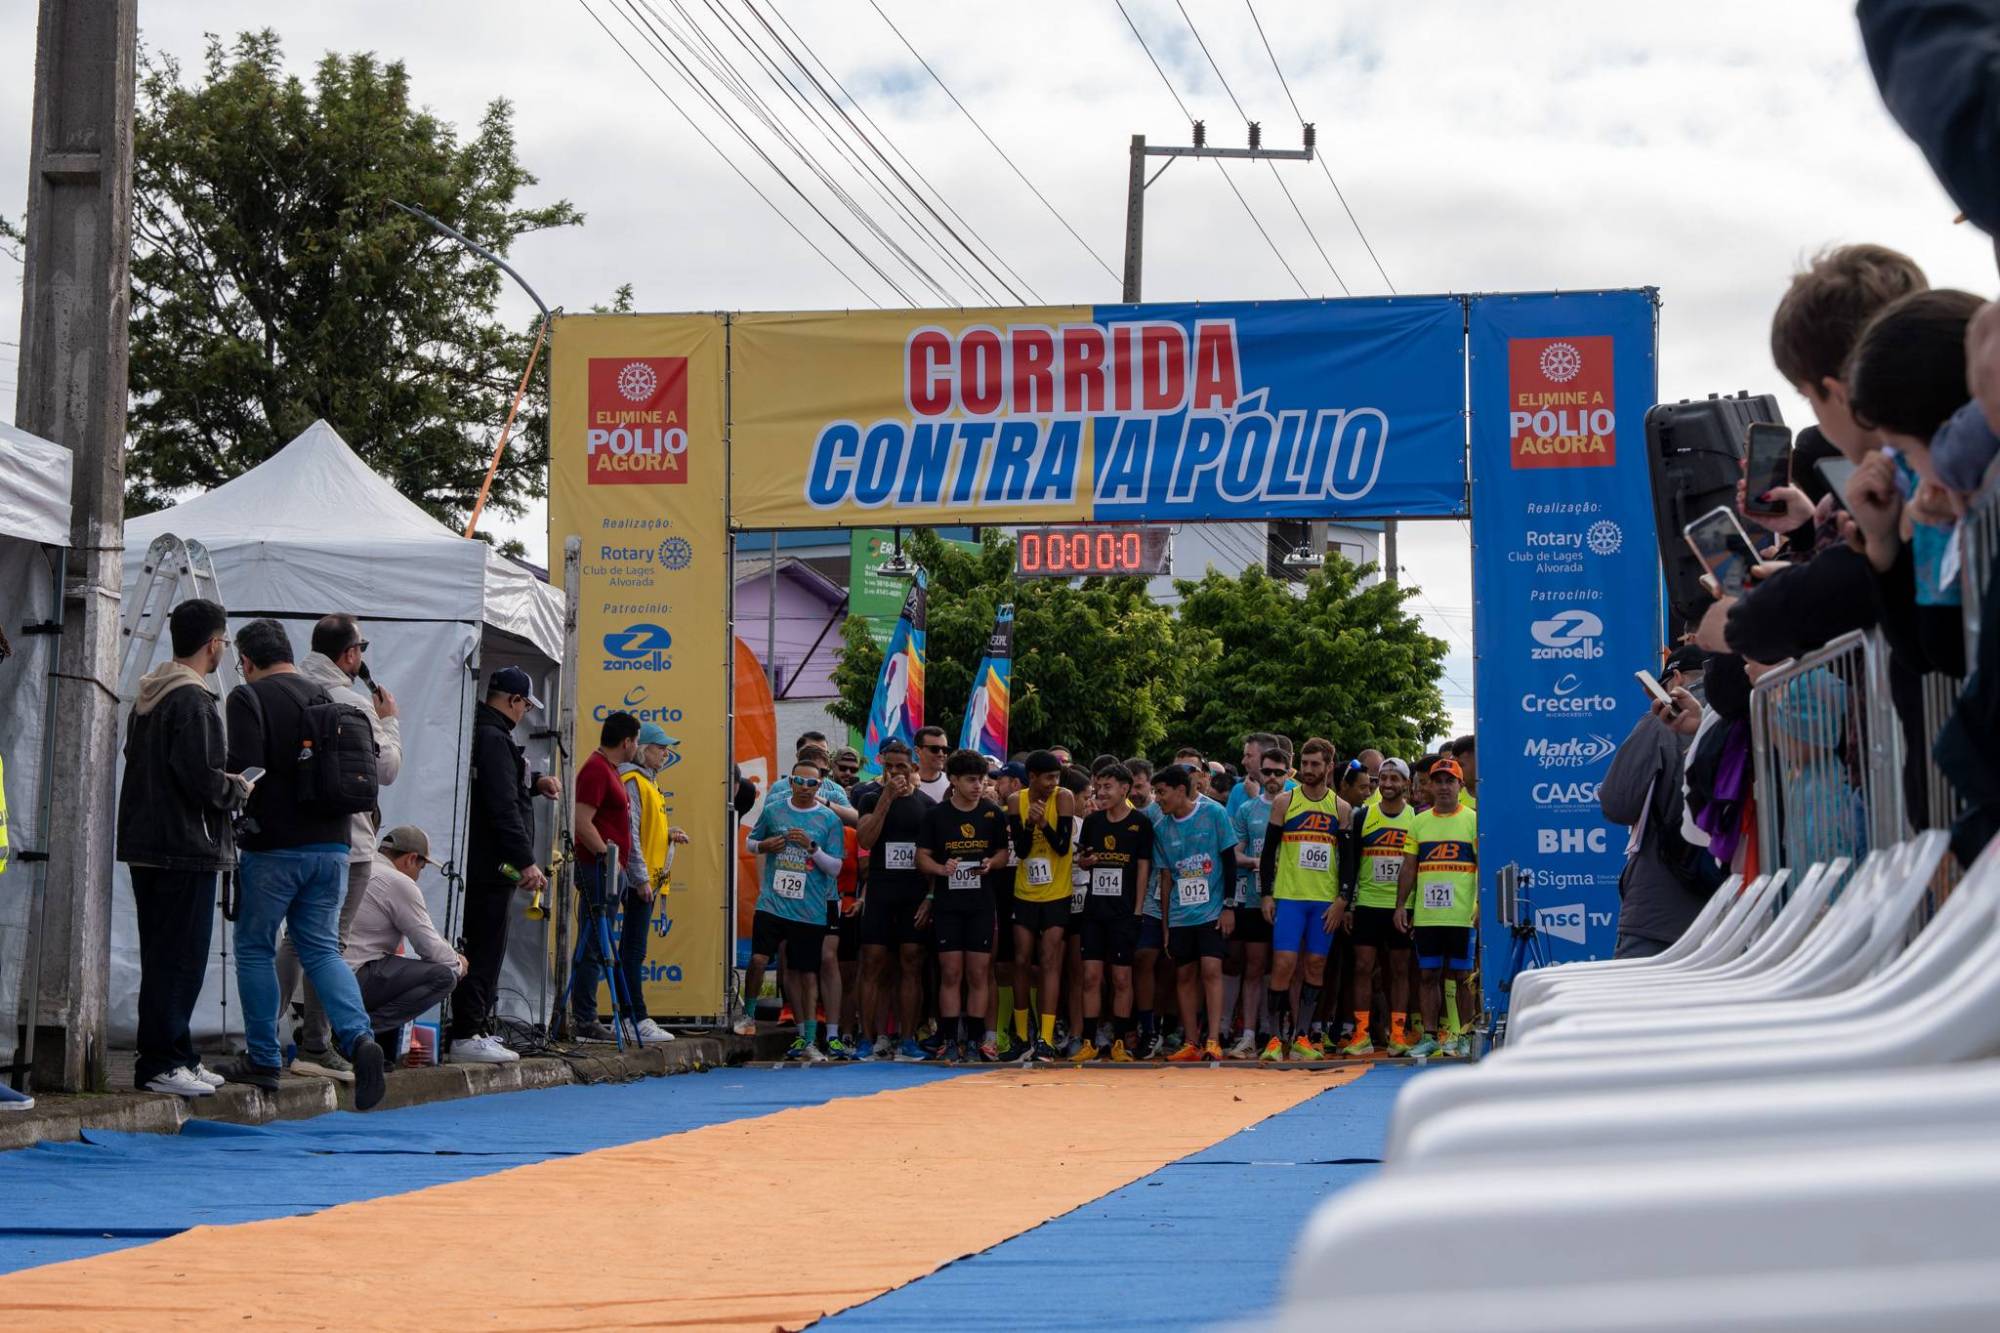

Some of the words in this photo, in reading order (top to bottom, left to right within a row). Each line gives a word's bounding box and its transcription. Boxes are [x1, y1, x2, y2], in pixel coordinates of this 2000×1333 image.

[905, 320, 1241, 417] CORRIDA
[1518, 392, 1588, 406] ELIMINE
[1592, 391, 1604, 404] A
[596, 411, 662, 424] ELIMINE
[666, 410, 678, 423] A
[1510, 403, 1616, 438] PÓLIO
[587, 422, 688, 455] PÓLIO
[1519, 436, 1606, 454] AGORA
[806, 418, 1084, 508] CONTRA
[1094, 414, 1158, 504] A
[1166, 387, 1389, 502] PÓLIO
[596, 453, 679, 471] AGORA
[1528, 502, 1603, 515] Realização:
[602, 518, 673, 530] Realização:
[1526, 531, 1583, 548] Rotary
[601, 546, 655, 563] Rotary
[1508, 551, 1534, 562] Club
[1537, 551, 1550, 561] de
[1553, 551, 1583, 563] Lages
[583, 566, 607, 576] Club
[610, 566, 623, 575] de
[626, 566, 655, 577] Lages
[1536, 563, 1583, 573] Alvorada
[609, 578, 655, 587] Alvorada
[1530, 589, 1604, 601] Patrocínio:
[603, 603, 673, 614] Patrocínio:
[1522, 694, 1617, 712] Crecerto
[593, 705, 683, 721] Ccerto
[1523, 738, 1598, 756] Marka
[1538, 756, 1584, 769] sports
[1296, 814, 1331, 830] AB
[1374, 830, 1407, 847] AB
[1538, 828, 1606, 853] BHC
[893, 850, 914, 861] 204
[1306, 849, 1327, 862] 066
[1425, 843, 1460, 860] AB
[1028, 864, 1047, 877] 011
[1381, 864, 1401, 875] 157
[781, 878, 802, 891] 129
[1099, 876, 1119, 888] 014
[1538, 870, 1595, 889] Sigma
[1184, 884, 1206, 896] 012
[1430, 890, 1450, 901] 121
[1541, 912, 1580, 927] nsc
[1589, 912, 1612, 927] TV
[640, 960, 683, 981] eira
